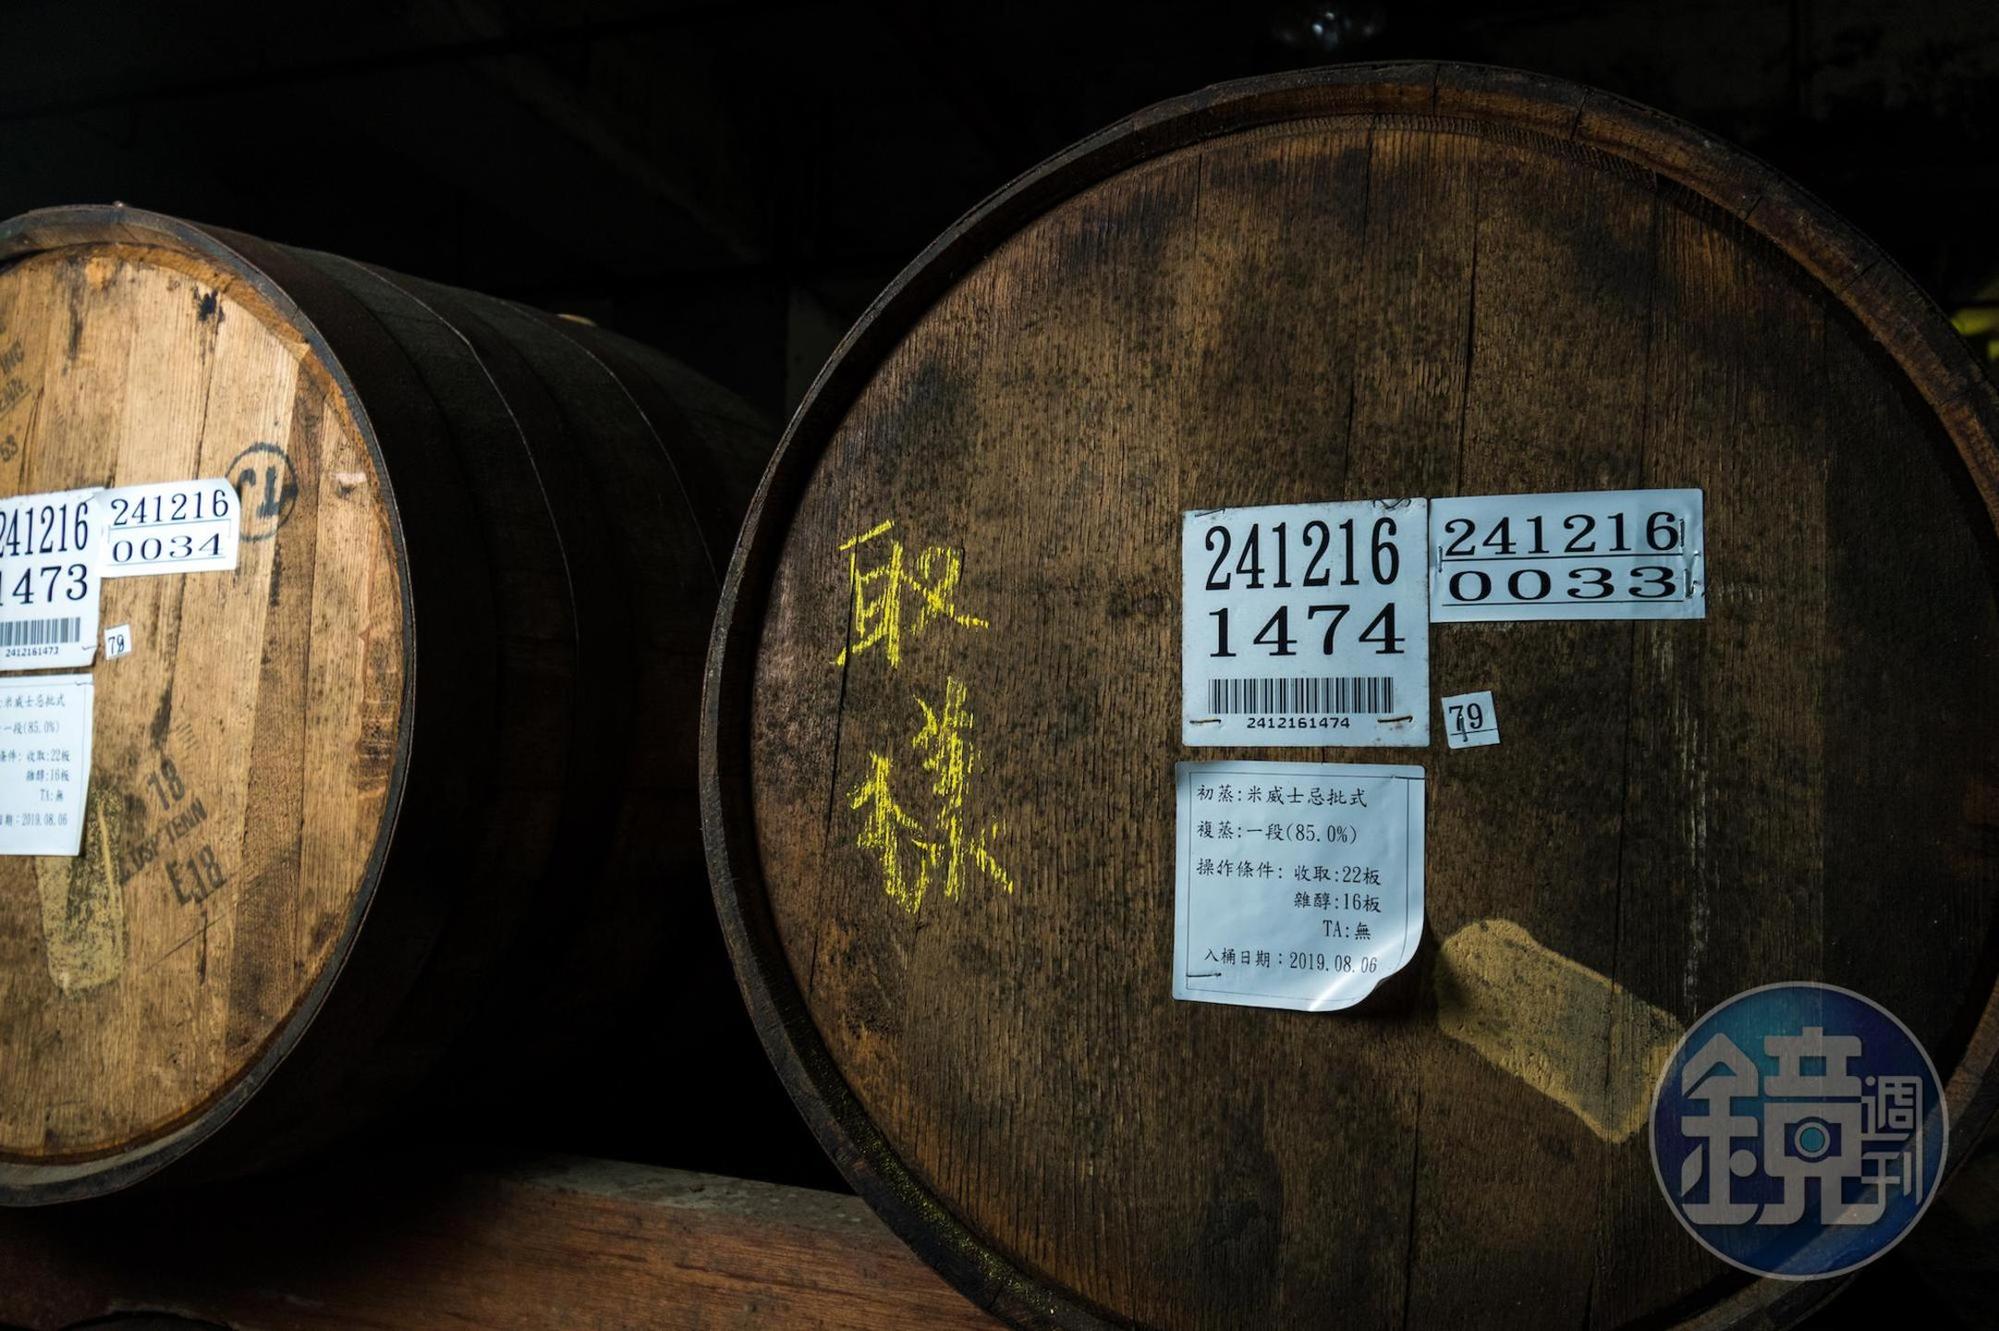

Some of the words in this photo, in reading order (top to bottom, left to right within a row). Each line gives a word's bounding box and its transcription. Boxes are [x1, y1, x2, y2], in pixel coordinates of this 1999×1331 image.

[111, 490, 229, 526] 241216
[113, 533, 223, 562] 0034
[1445, 511, 1679, 556] 241216
[1205, 517, 1400, 591] 241216
[1450, 566, 1677, 601] 0033
[1209, 603, 1405, 657] 1474
[5, 646, 59, 657] 2412161473
[1247, 717, 1350, 730] 2412161474
[1449, 703, 1484, 733] 79
[1197, 784, 1368, 808] 初蒸:米威士忌批式
[0, 813, 68, 827] 期:2019.08.06
[1294, 865, 1382, 886] 收取:22板
[1323, 919, 1371, 940] TA:無
